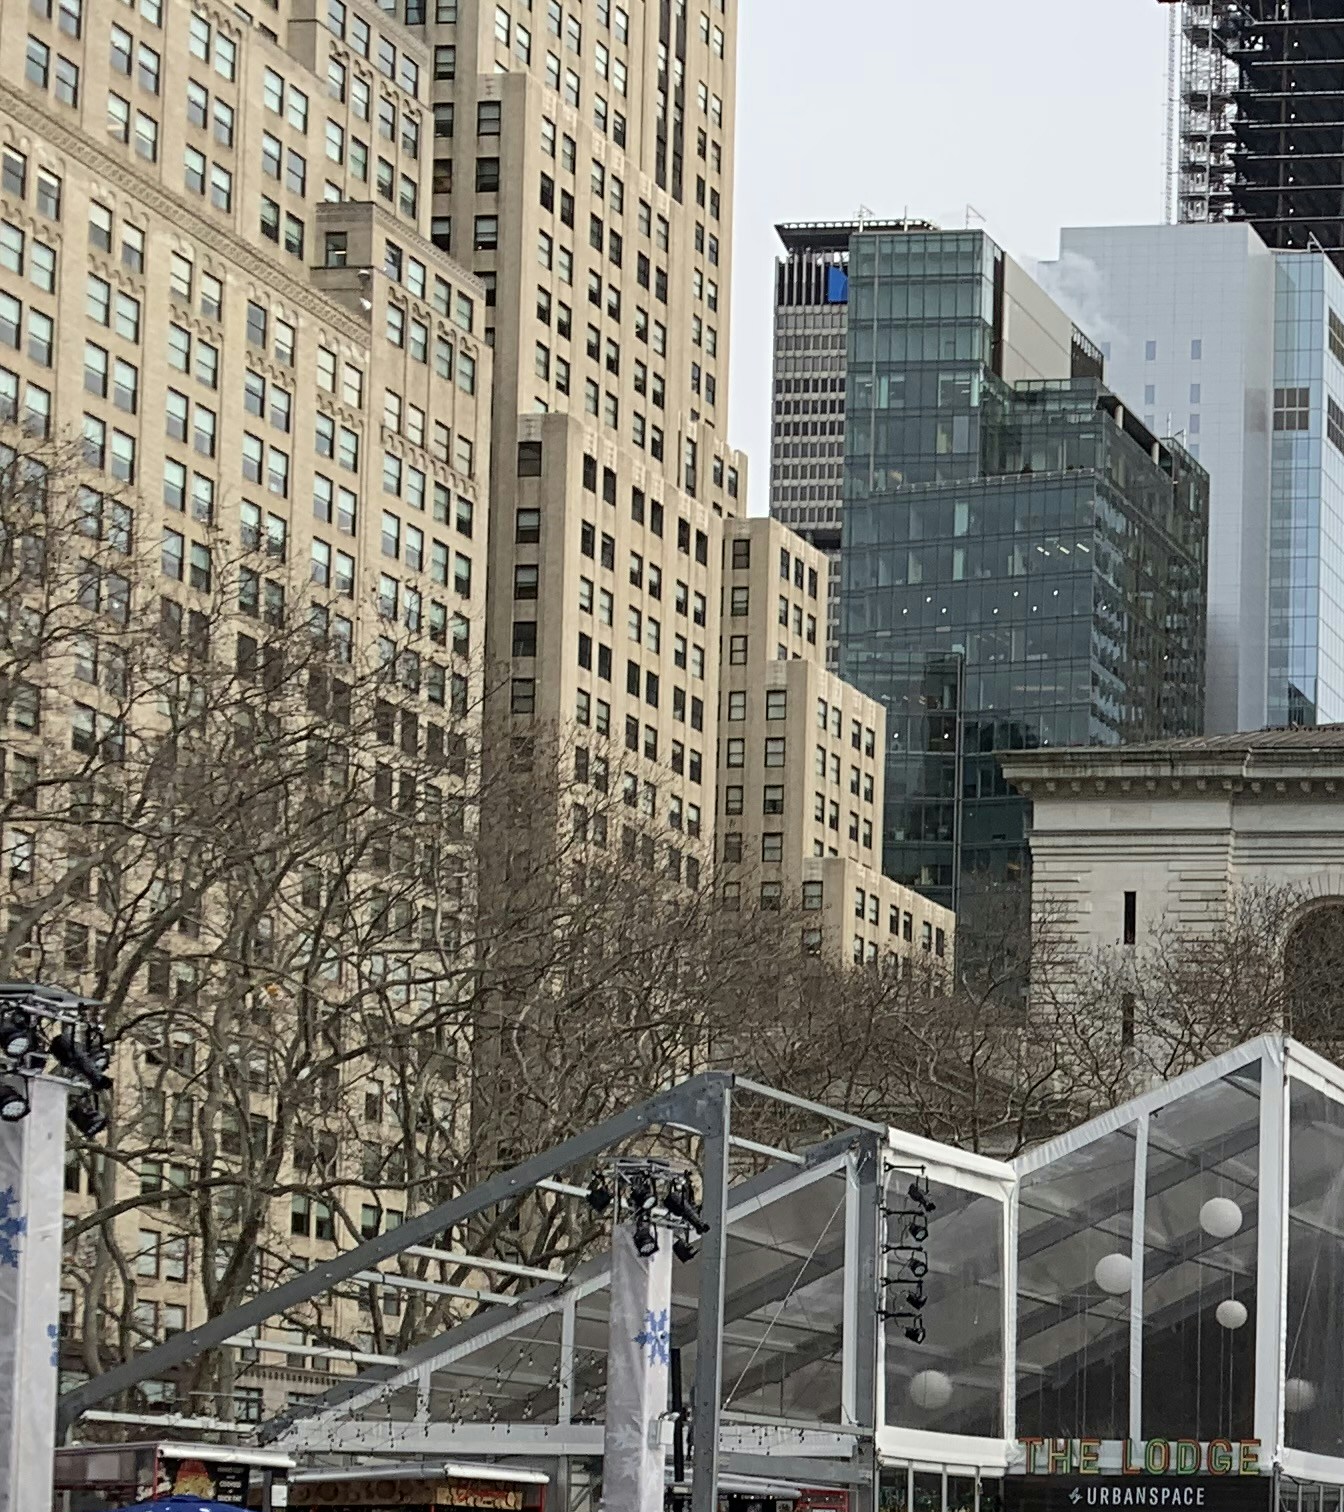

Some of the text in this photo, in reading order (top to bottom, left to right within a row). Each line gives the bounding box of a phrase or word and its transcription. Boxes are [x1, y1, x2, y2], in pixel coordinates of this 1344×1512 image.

[1018, 1436, 1262, 1476] THE LODGE
[1068, 1486, 1205, 1506] by URBANSPACE
